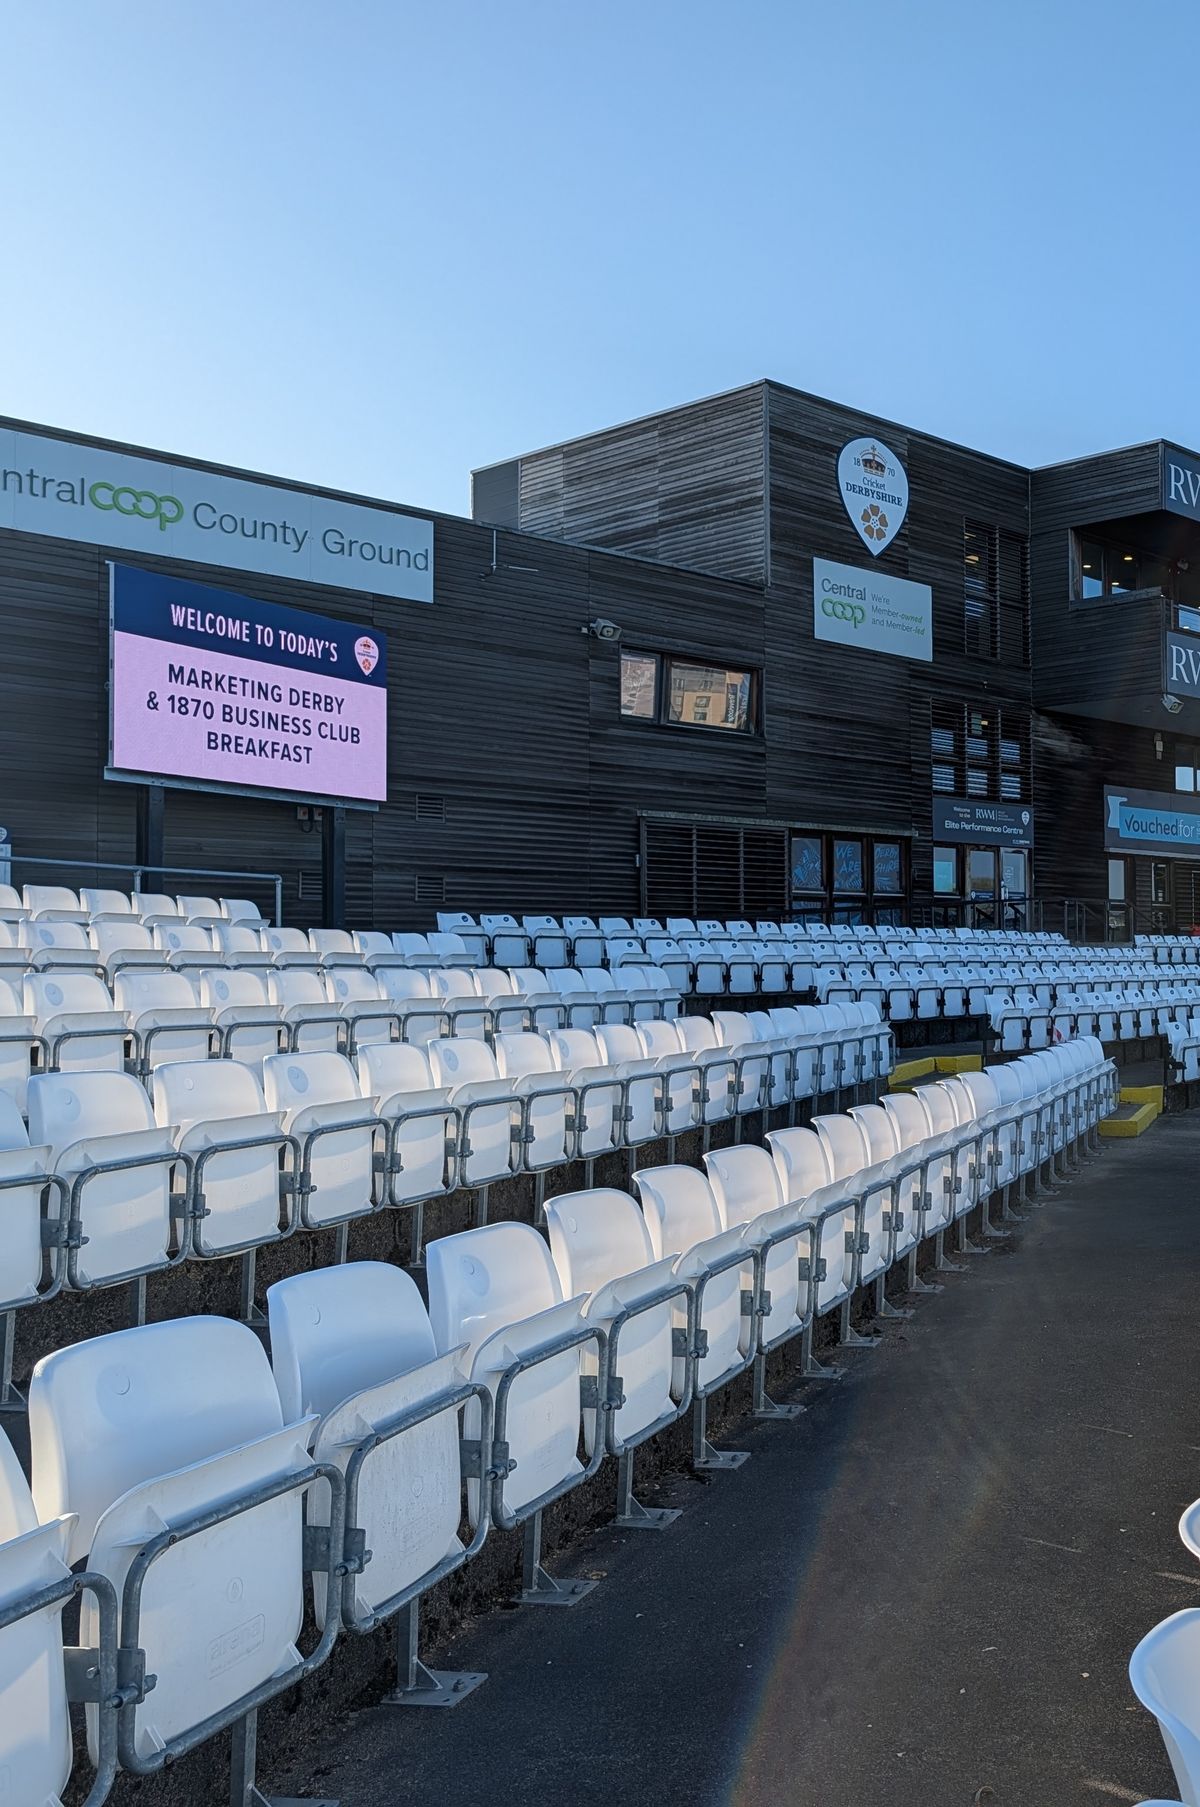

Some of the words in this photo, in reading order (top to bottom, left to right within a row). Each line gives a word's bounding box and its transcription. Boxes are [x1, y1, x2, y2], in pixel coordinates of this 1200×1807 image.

[854, 457, 860, 467] 18
[888, 467, 896, 477] 70
[846, 482, 902, 507] DERBYSHIRE
[862, 477, 886, 491] Cricket
[193, 502, 309, 552] County
[322, 528, 429, 572] Ground
[821, 578, 866, 601] Central
[871, 594, 890, 605] We're
[821, 597, 865, 628] coop
[871, 605, 922, 623] Member-owned
[171, 604, 250, 644] WELCOME
[255, 624, 274, 647] TO
[279, 630, 338, 663] TODAY'S
[871, 617, 884, 628] and
[886, 620, 925, 636] Member-led
[168, 663, 282, 703] MARKETING
[289, 687, 345, 715] DERBY
[147, 690, 159, 711] &
[167, 694, 214, 720] 1870
[222, 704, 312, 736] BUSINESS
[318, 722, 361, 745] CLUB
[207, 731, 312, 765] BREAKFAST
[976, 808, 995, 820] RWM
[945, 820, 960, 829] Elite
[961, 822, 1001, 833] Performance
[1003, 826, 1023, 835] Centre
